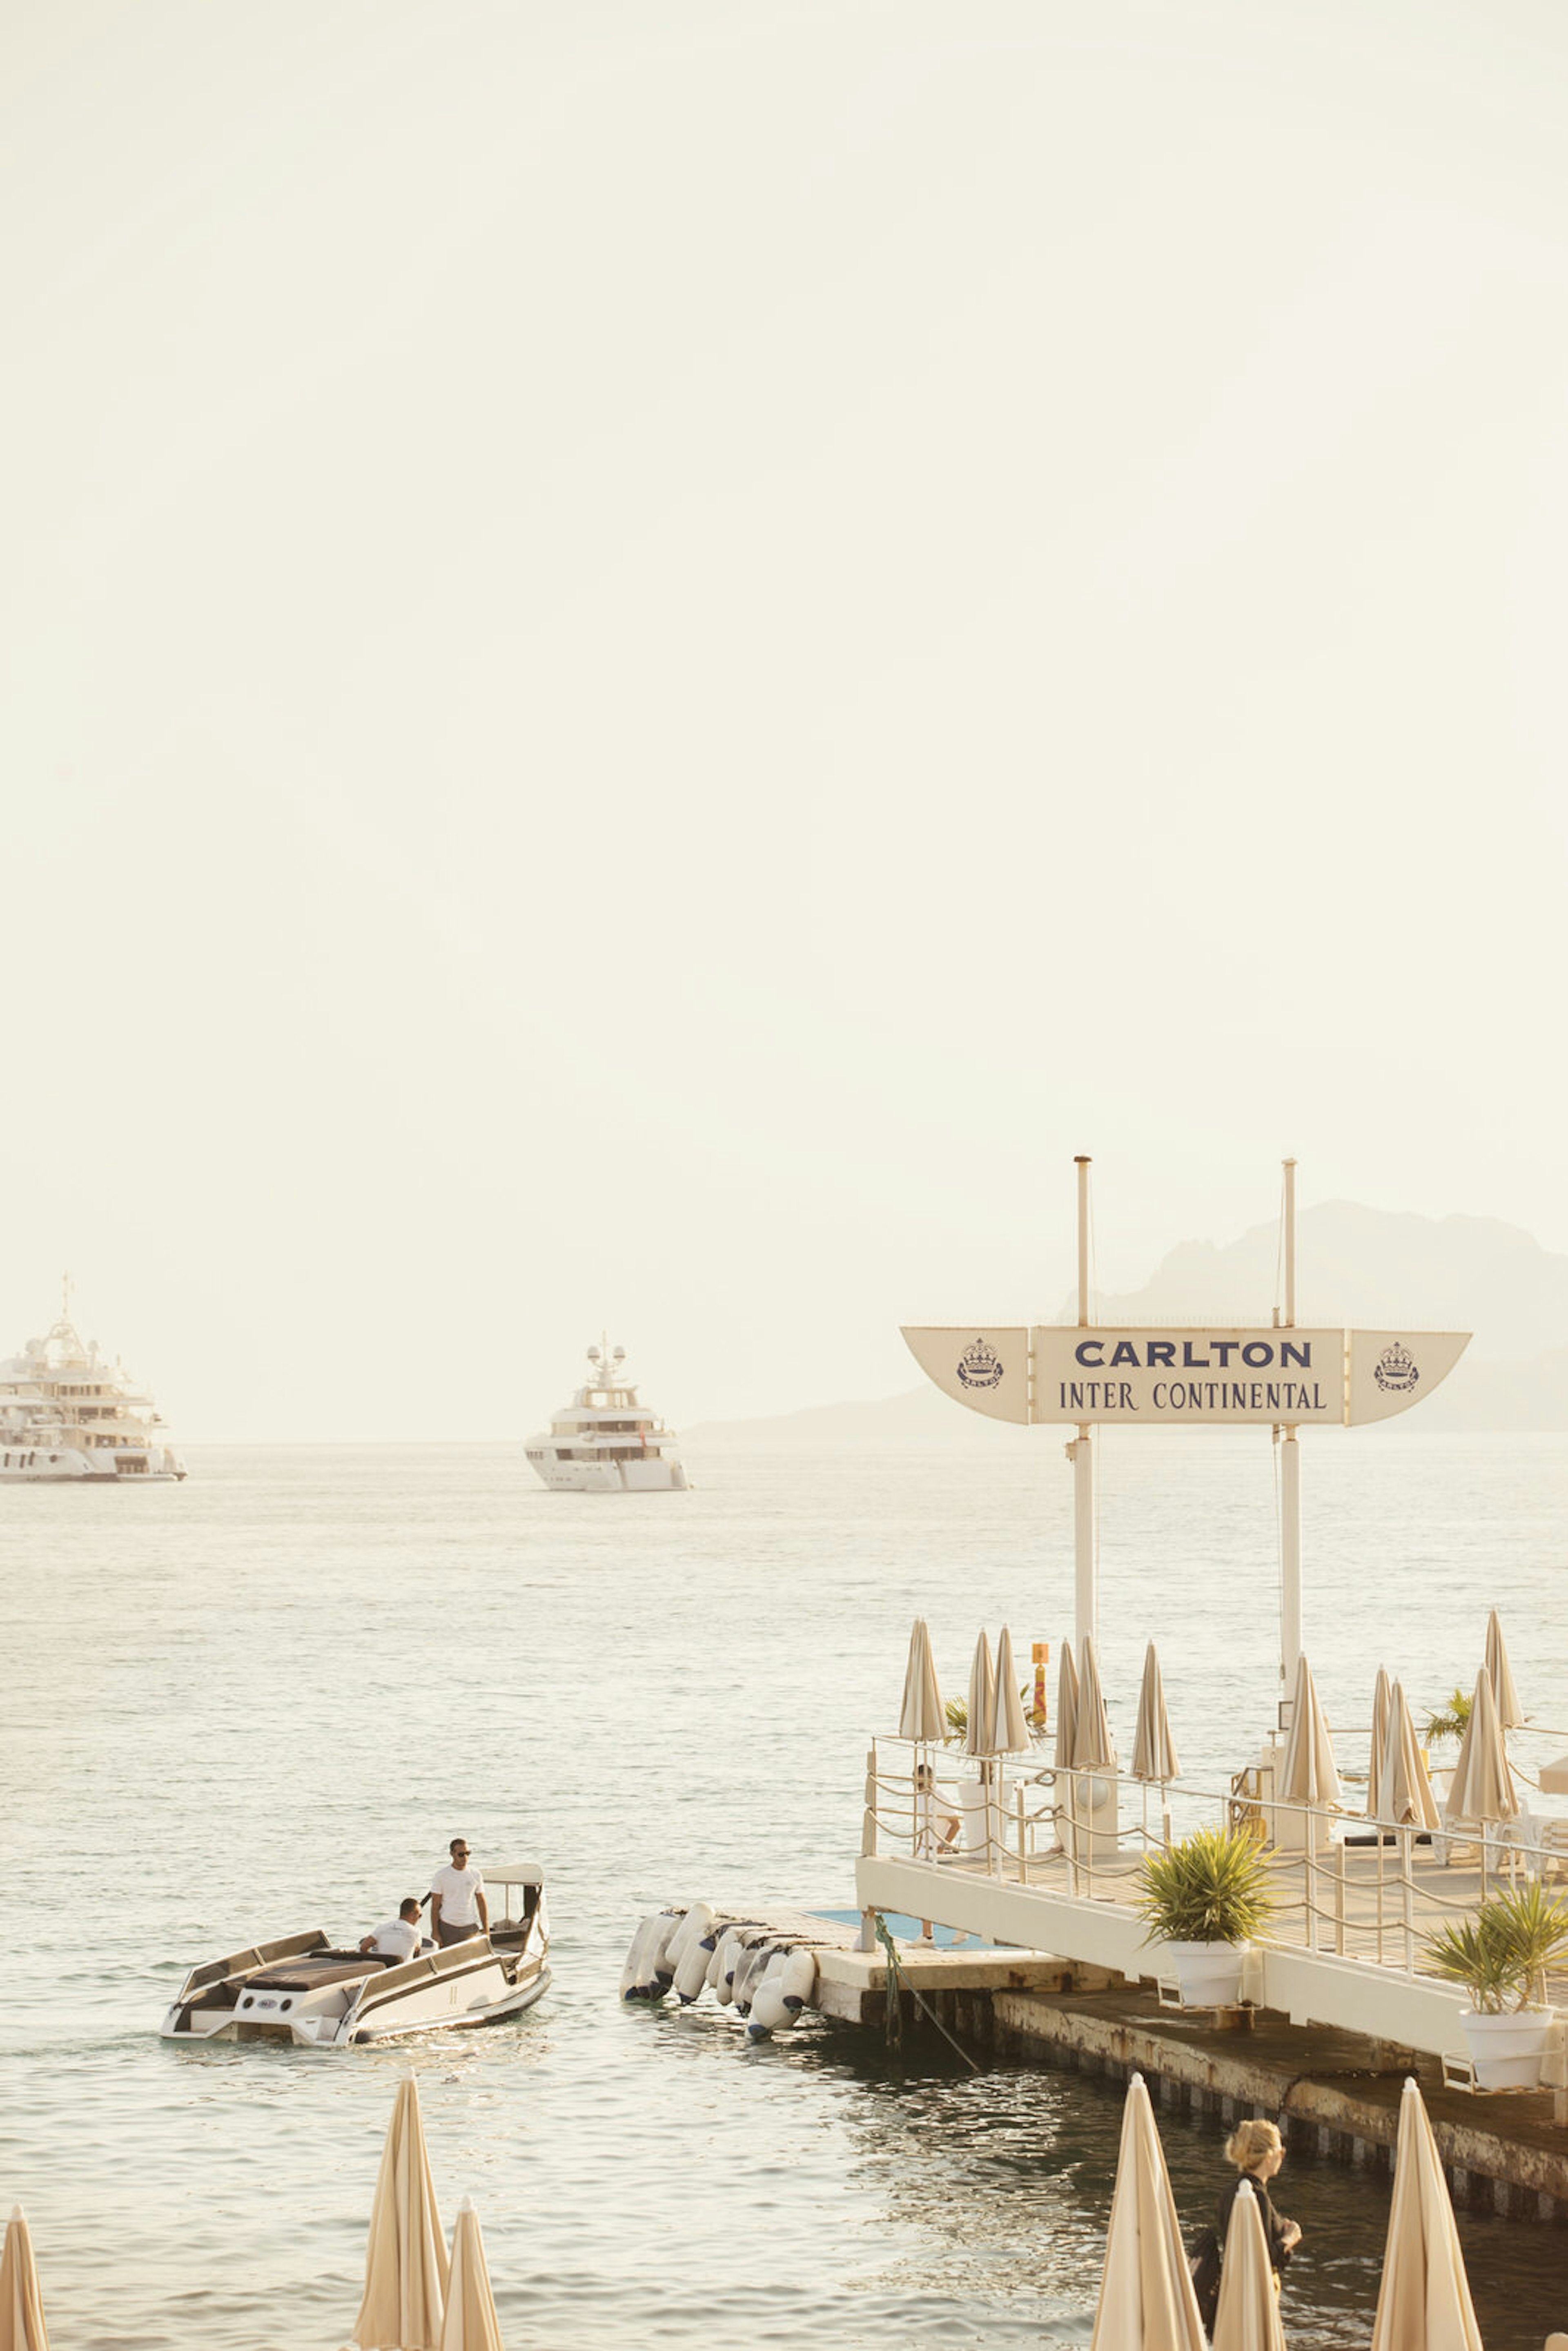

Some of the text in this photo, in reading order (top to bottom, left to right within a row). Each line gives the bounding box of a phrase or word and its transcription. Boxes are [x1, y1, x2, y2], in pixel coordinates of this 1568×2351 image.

[1075, 1340, 1311, 1368] CARLTON
[1060, 1382, 1327, 1411] INTER CONTINENTAL
